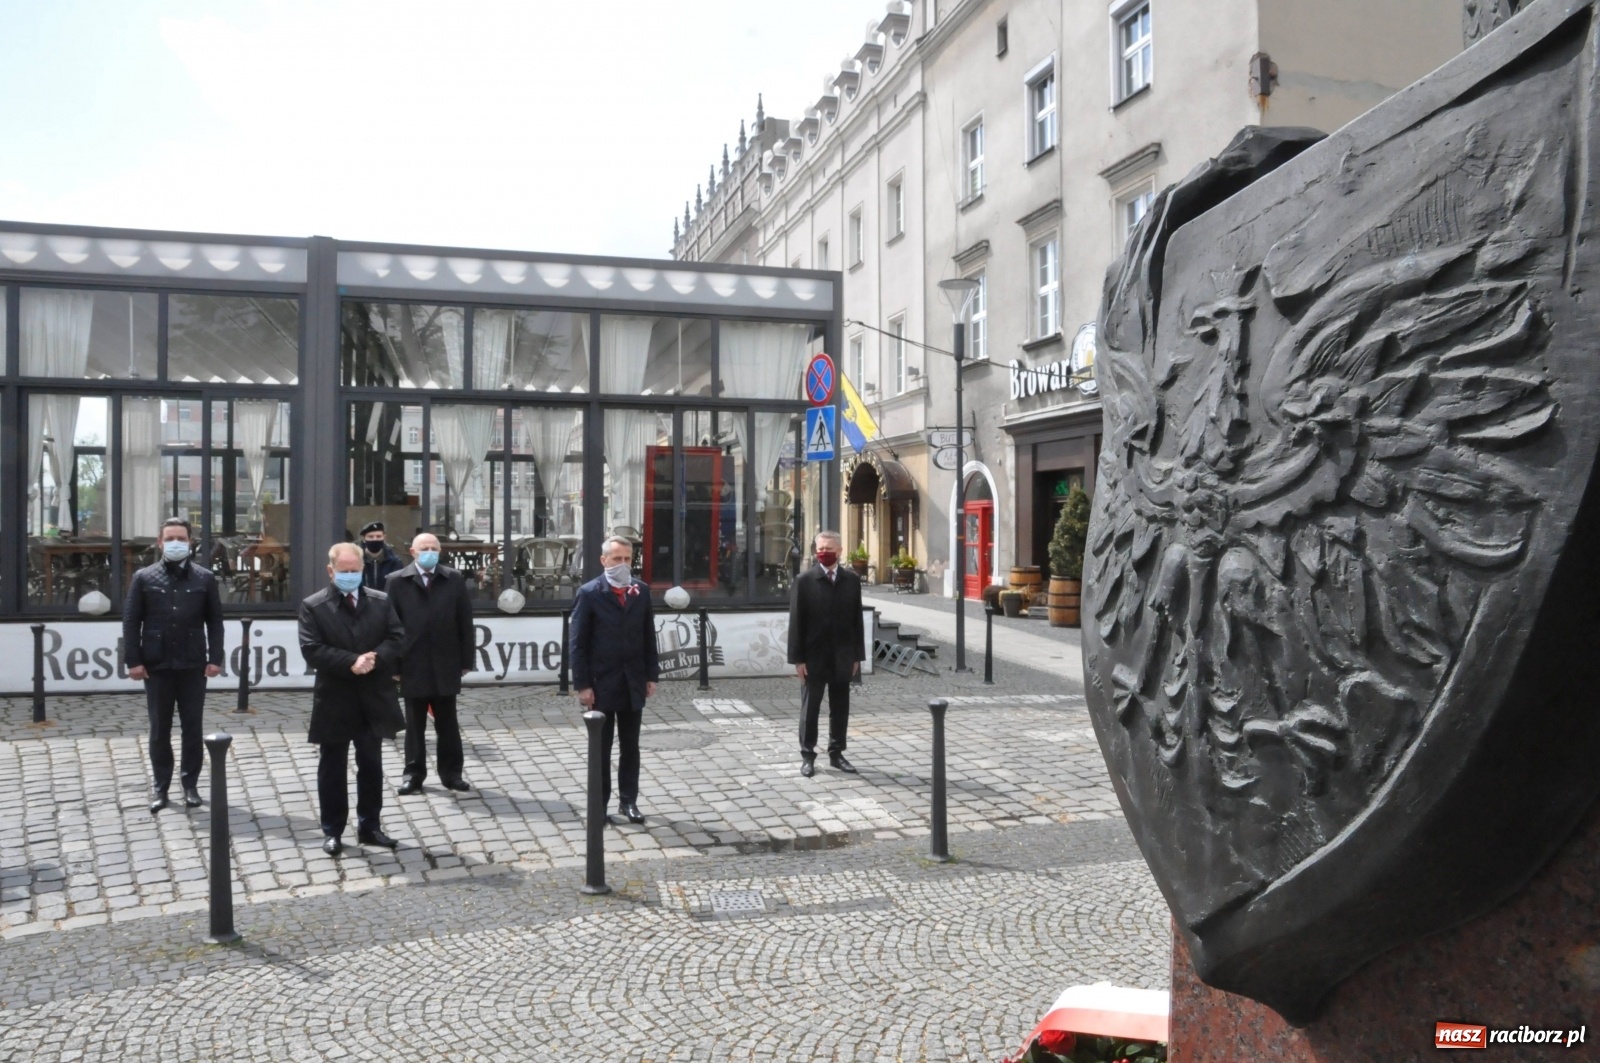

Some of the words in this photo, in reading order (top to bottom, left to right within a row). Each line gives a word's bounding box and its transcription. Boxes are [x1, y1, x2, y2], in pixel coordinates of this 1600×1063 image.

[1009, 358, 1070, 401] Browar
[32, 628, 289, 686] Restcja
[474, 624, 563, 681] Ryne
[678, 648, 713, 668] Rynk
